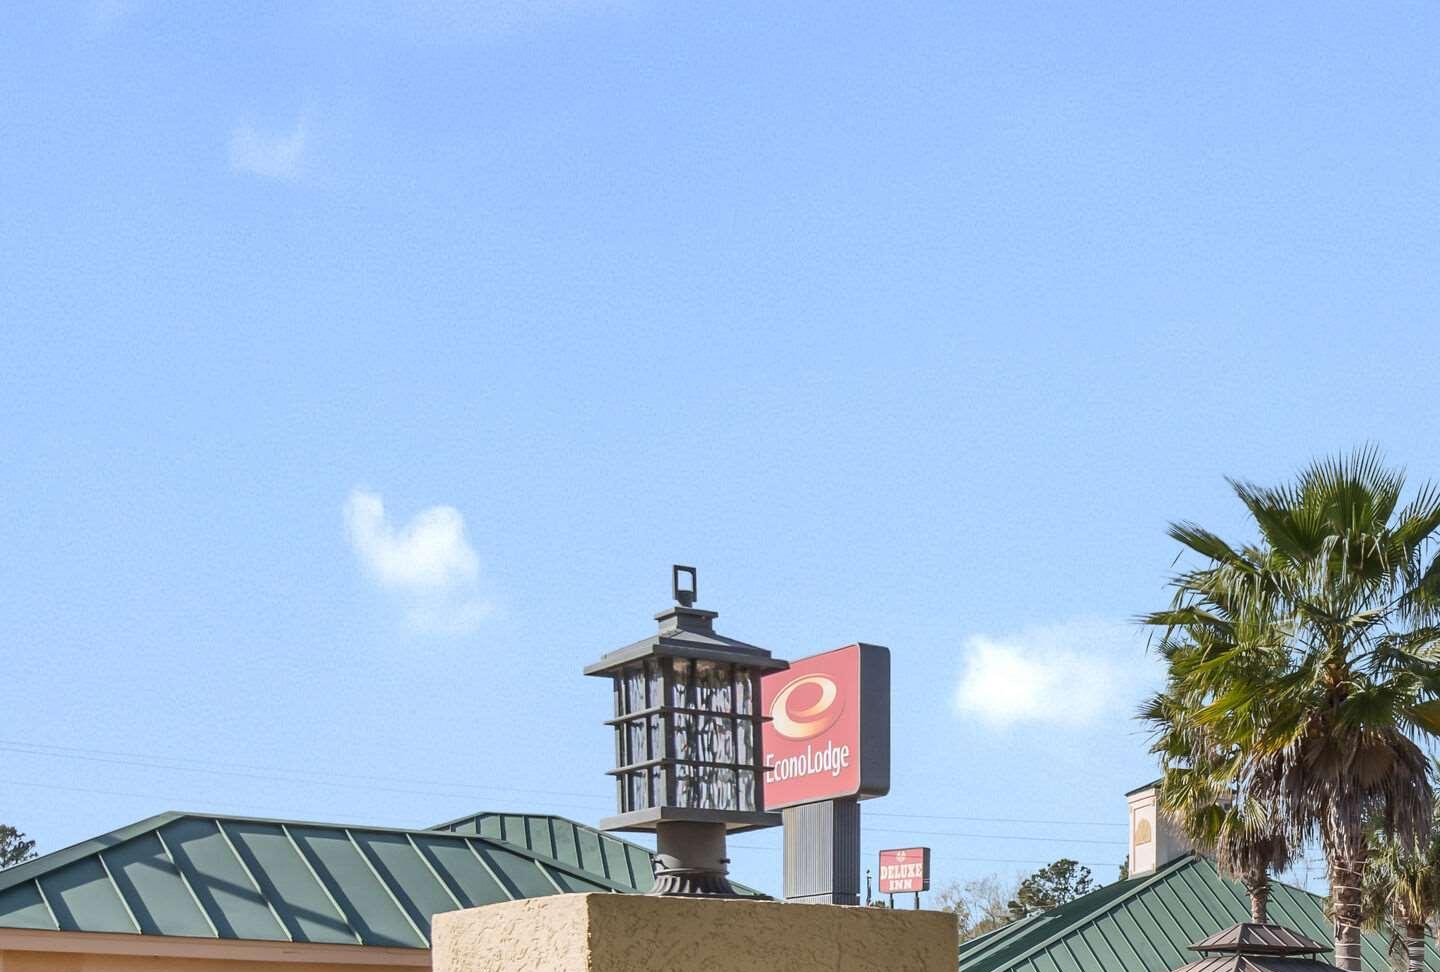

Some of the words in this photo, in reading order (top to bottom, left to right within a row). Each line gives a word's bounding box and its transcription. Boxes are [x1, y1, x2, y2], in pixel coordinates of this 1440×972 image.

[765, 740, 849, 784] EconoLodge
[880, 863, 923, 879] DELUXE
[889, 879, 913, 890] INN
